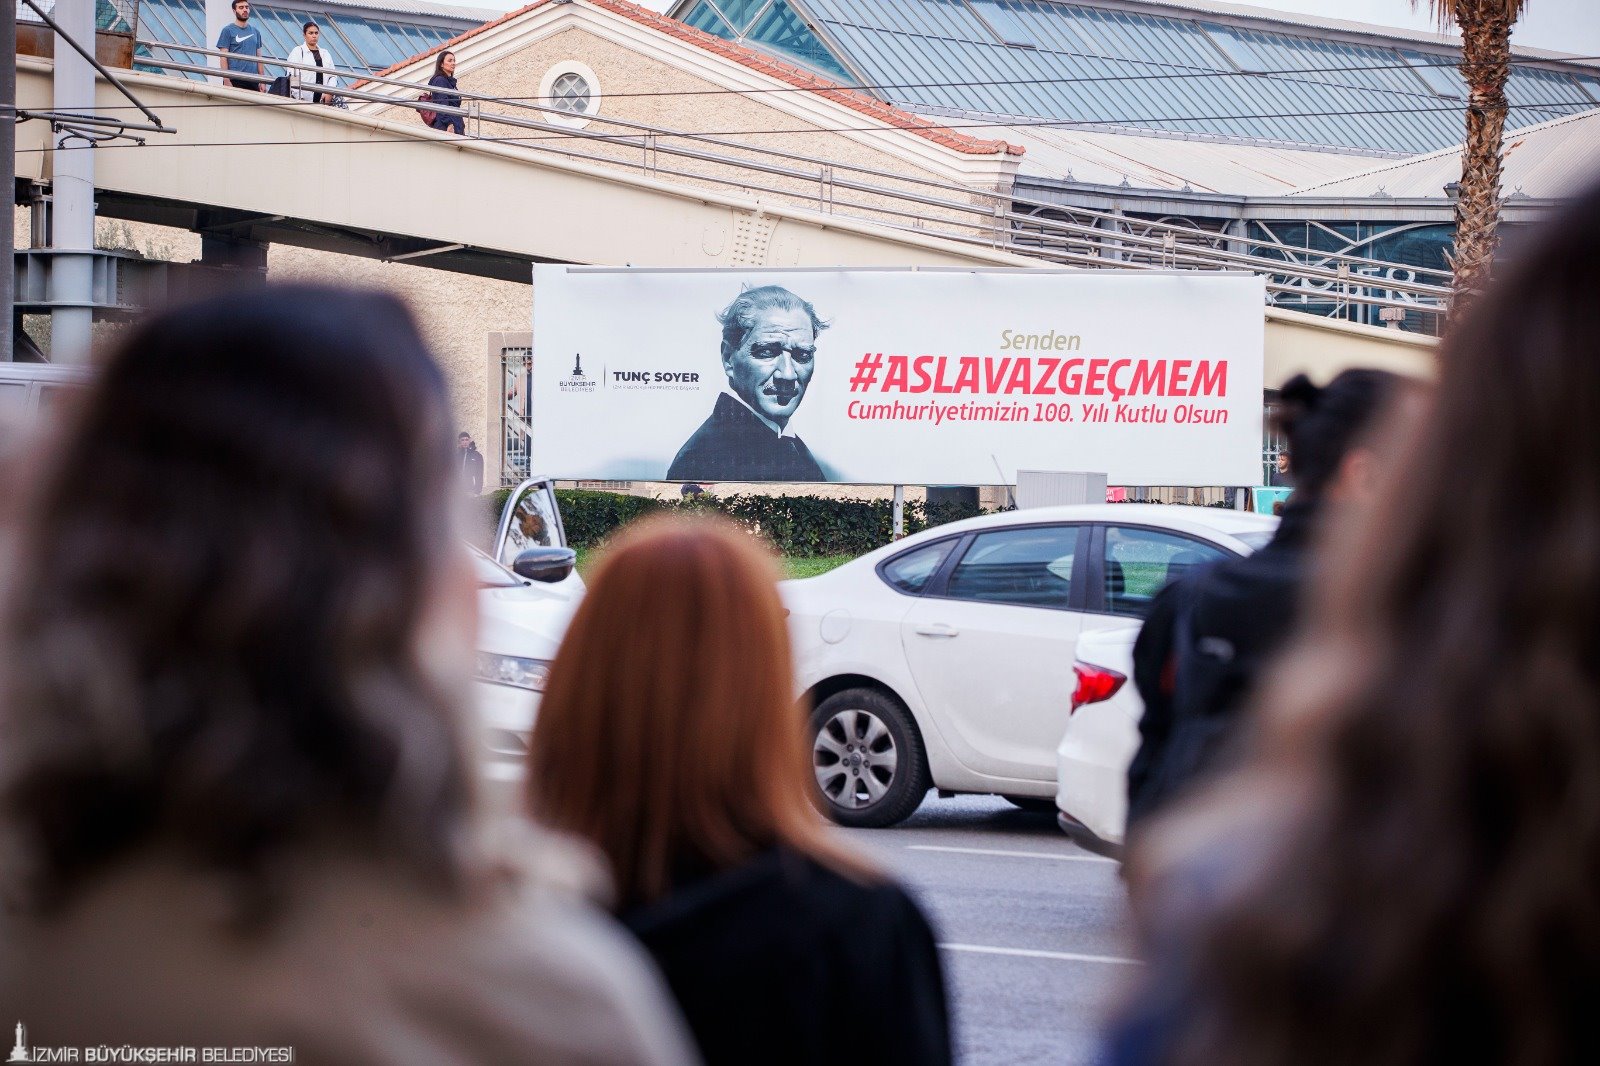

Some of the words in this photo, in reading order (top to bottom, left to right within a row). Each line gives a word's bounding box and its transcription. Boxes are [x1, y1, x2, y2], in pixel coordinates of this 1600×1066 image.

[1000, 329, 1081, 351] Senden
[613, 371, 651, 385] TUNÇ
[655, 372, 700, 383] SOYER
[849, 353, 1228, 402] #ASLAVAZGEÇMEM
[847, 400, 1029, 426] Cumhuriyetimizin
[1033, 403, 1074, 422] 100.
[1082, 403, 1110, 423] Yılı
[1115, 404, 1168, 424] Kutlu
[1173, 404, 1229, 424] Olsun
